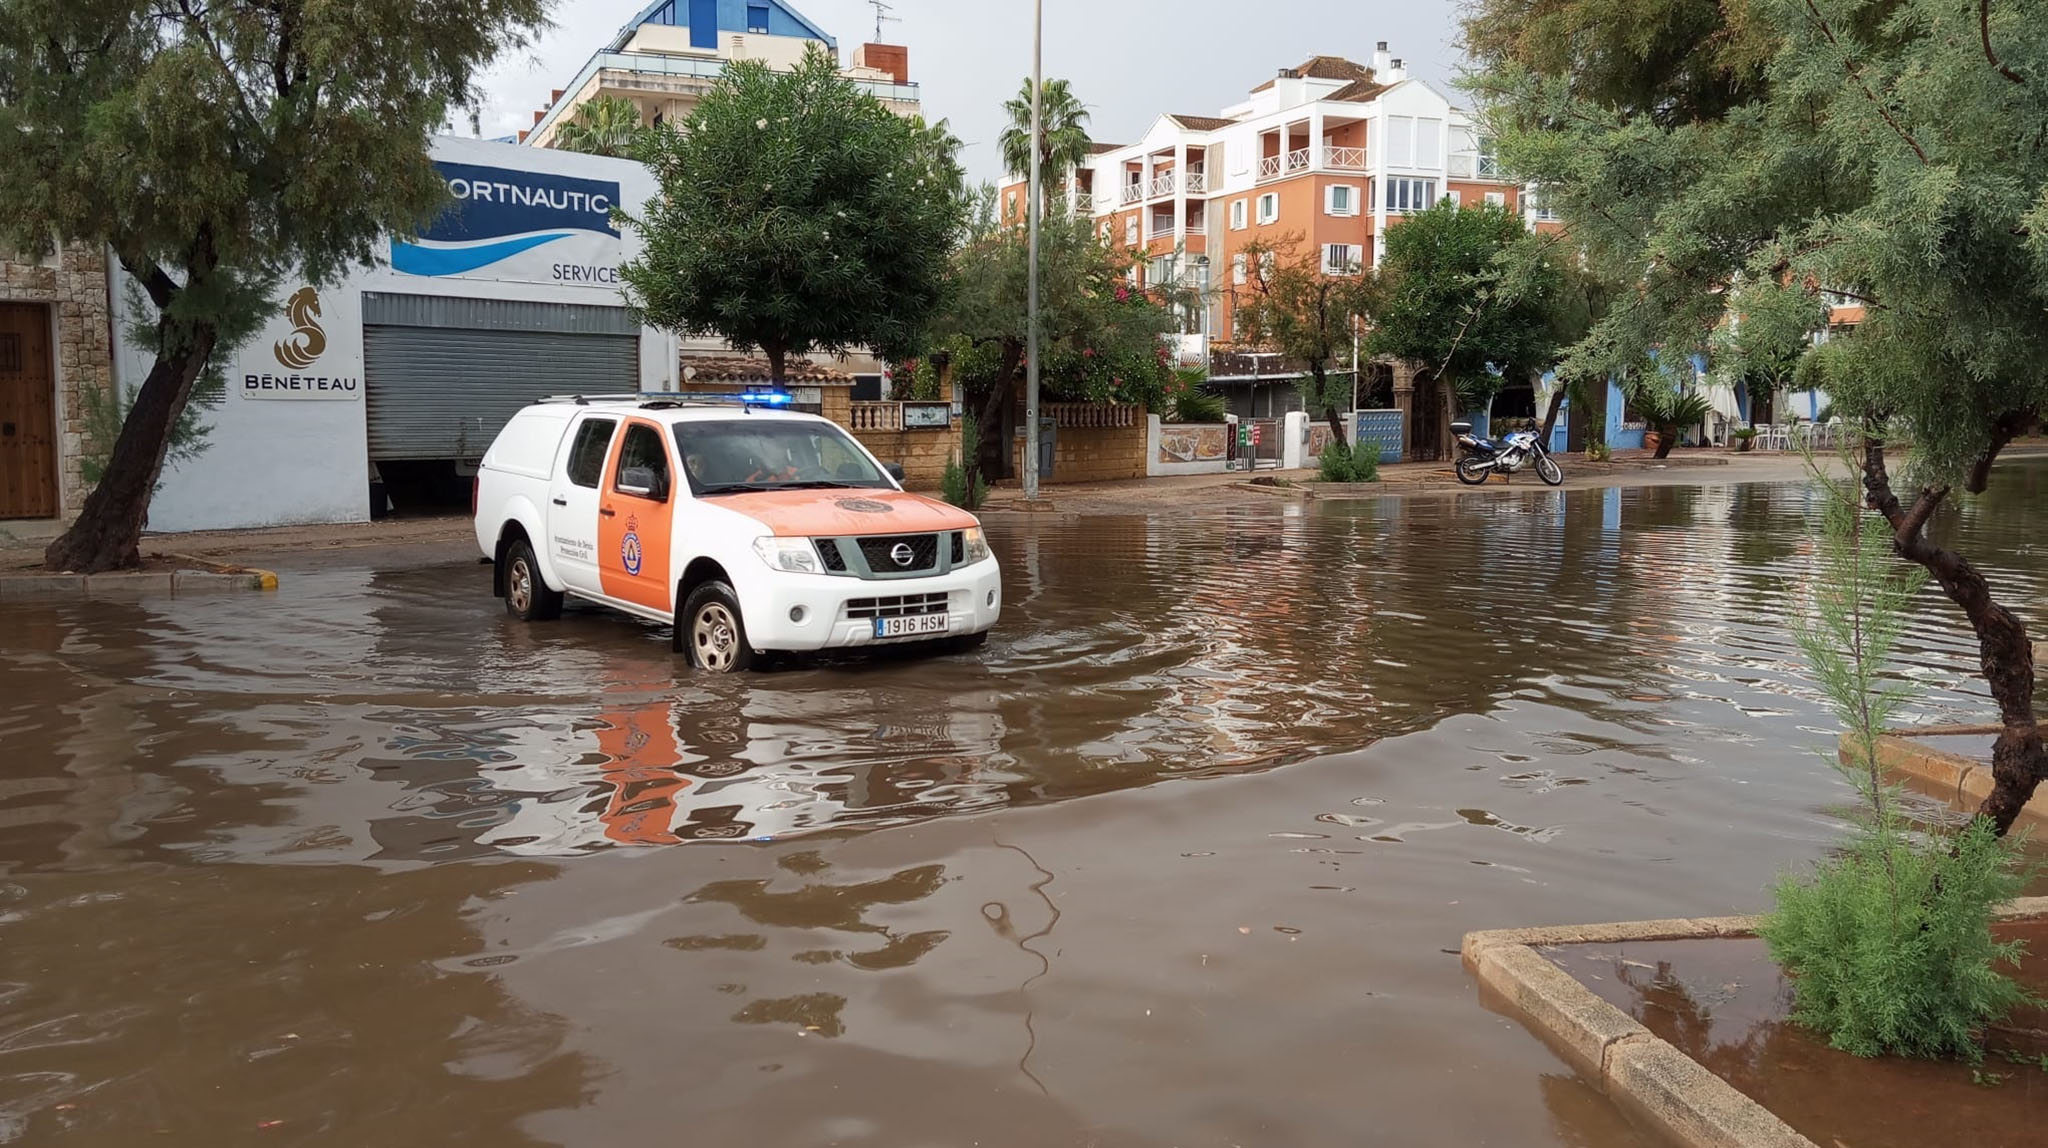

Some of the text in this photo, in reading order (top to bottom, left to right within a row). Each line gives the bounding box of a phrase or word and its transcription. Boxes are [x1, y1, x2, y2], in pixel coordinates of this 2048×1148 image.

[440, 177, 609, 214] ORTNAUTIC
[552, 263, 618, 284] SERVICE
[887, 615, 945, 634] 1916 HSM
